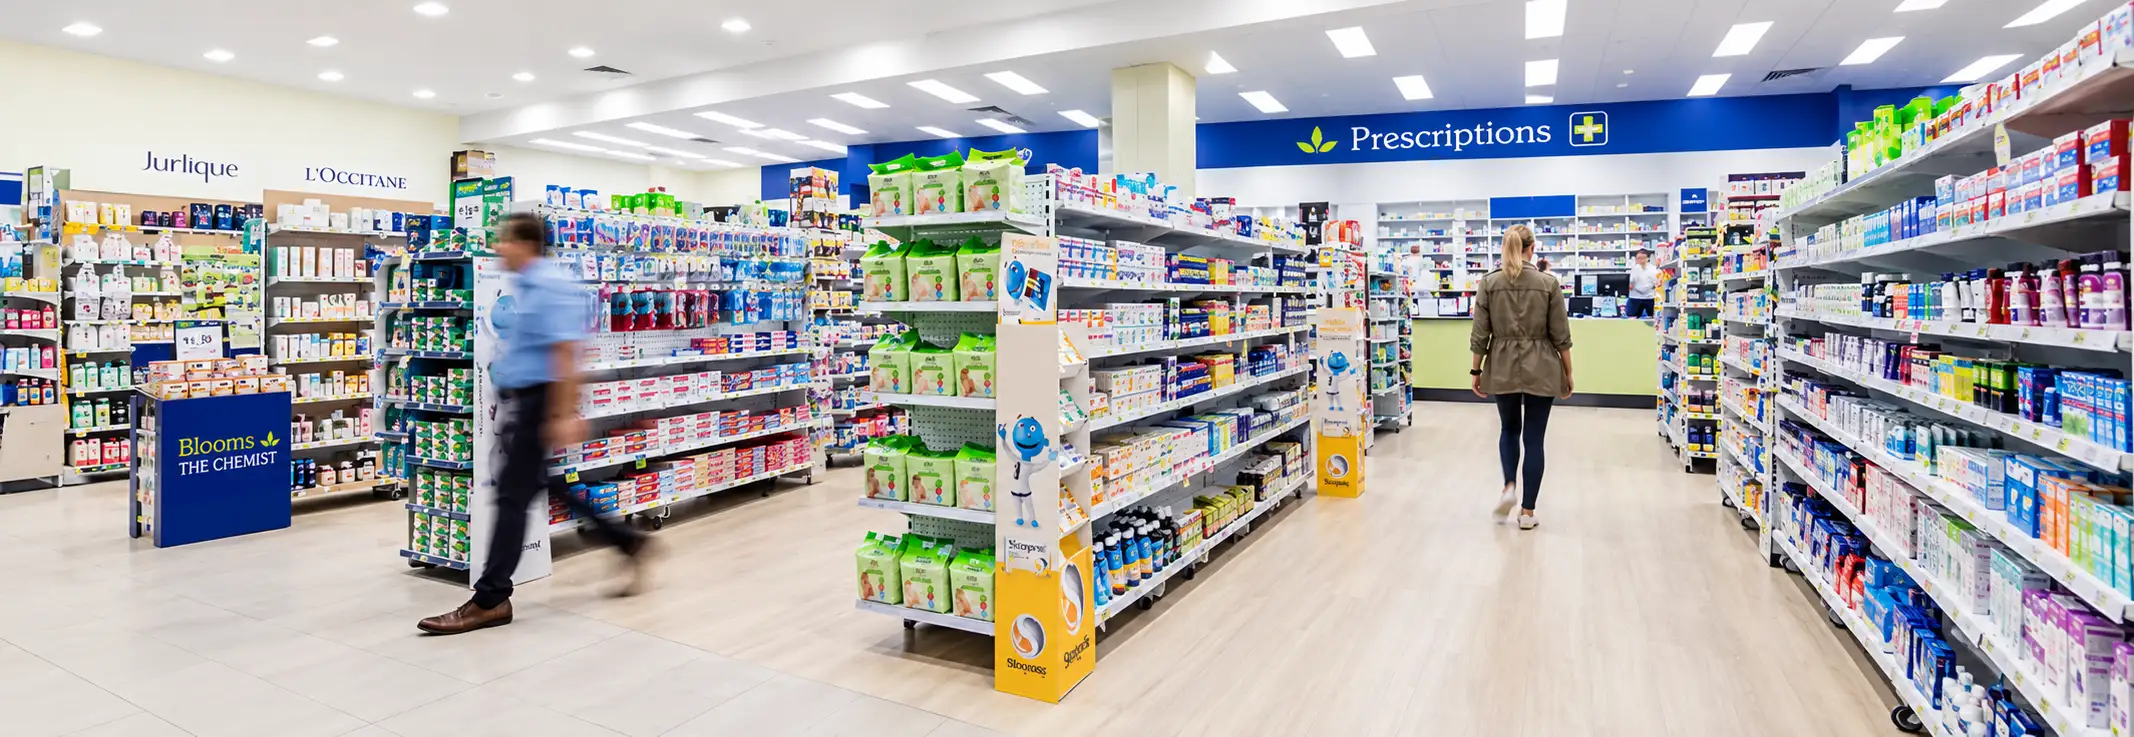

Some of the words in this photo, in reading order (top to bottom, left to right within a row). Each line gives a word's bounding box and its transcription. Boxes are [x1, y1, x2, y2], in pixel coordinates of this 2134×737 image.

[1351, 122, 1551, 152] Prescriptions
[143, 151, 239, 183] Jurlique
[305, 167, 407, 190] L'OCCITANE
[178, 435, 255, 457] Blooms
[178, 459, 209, 476] THE
[212, 451, 278, 472] CHEMIST
